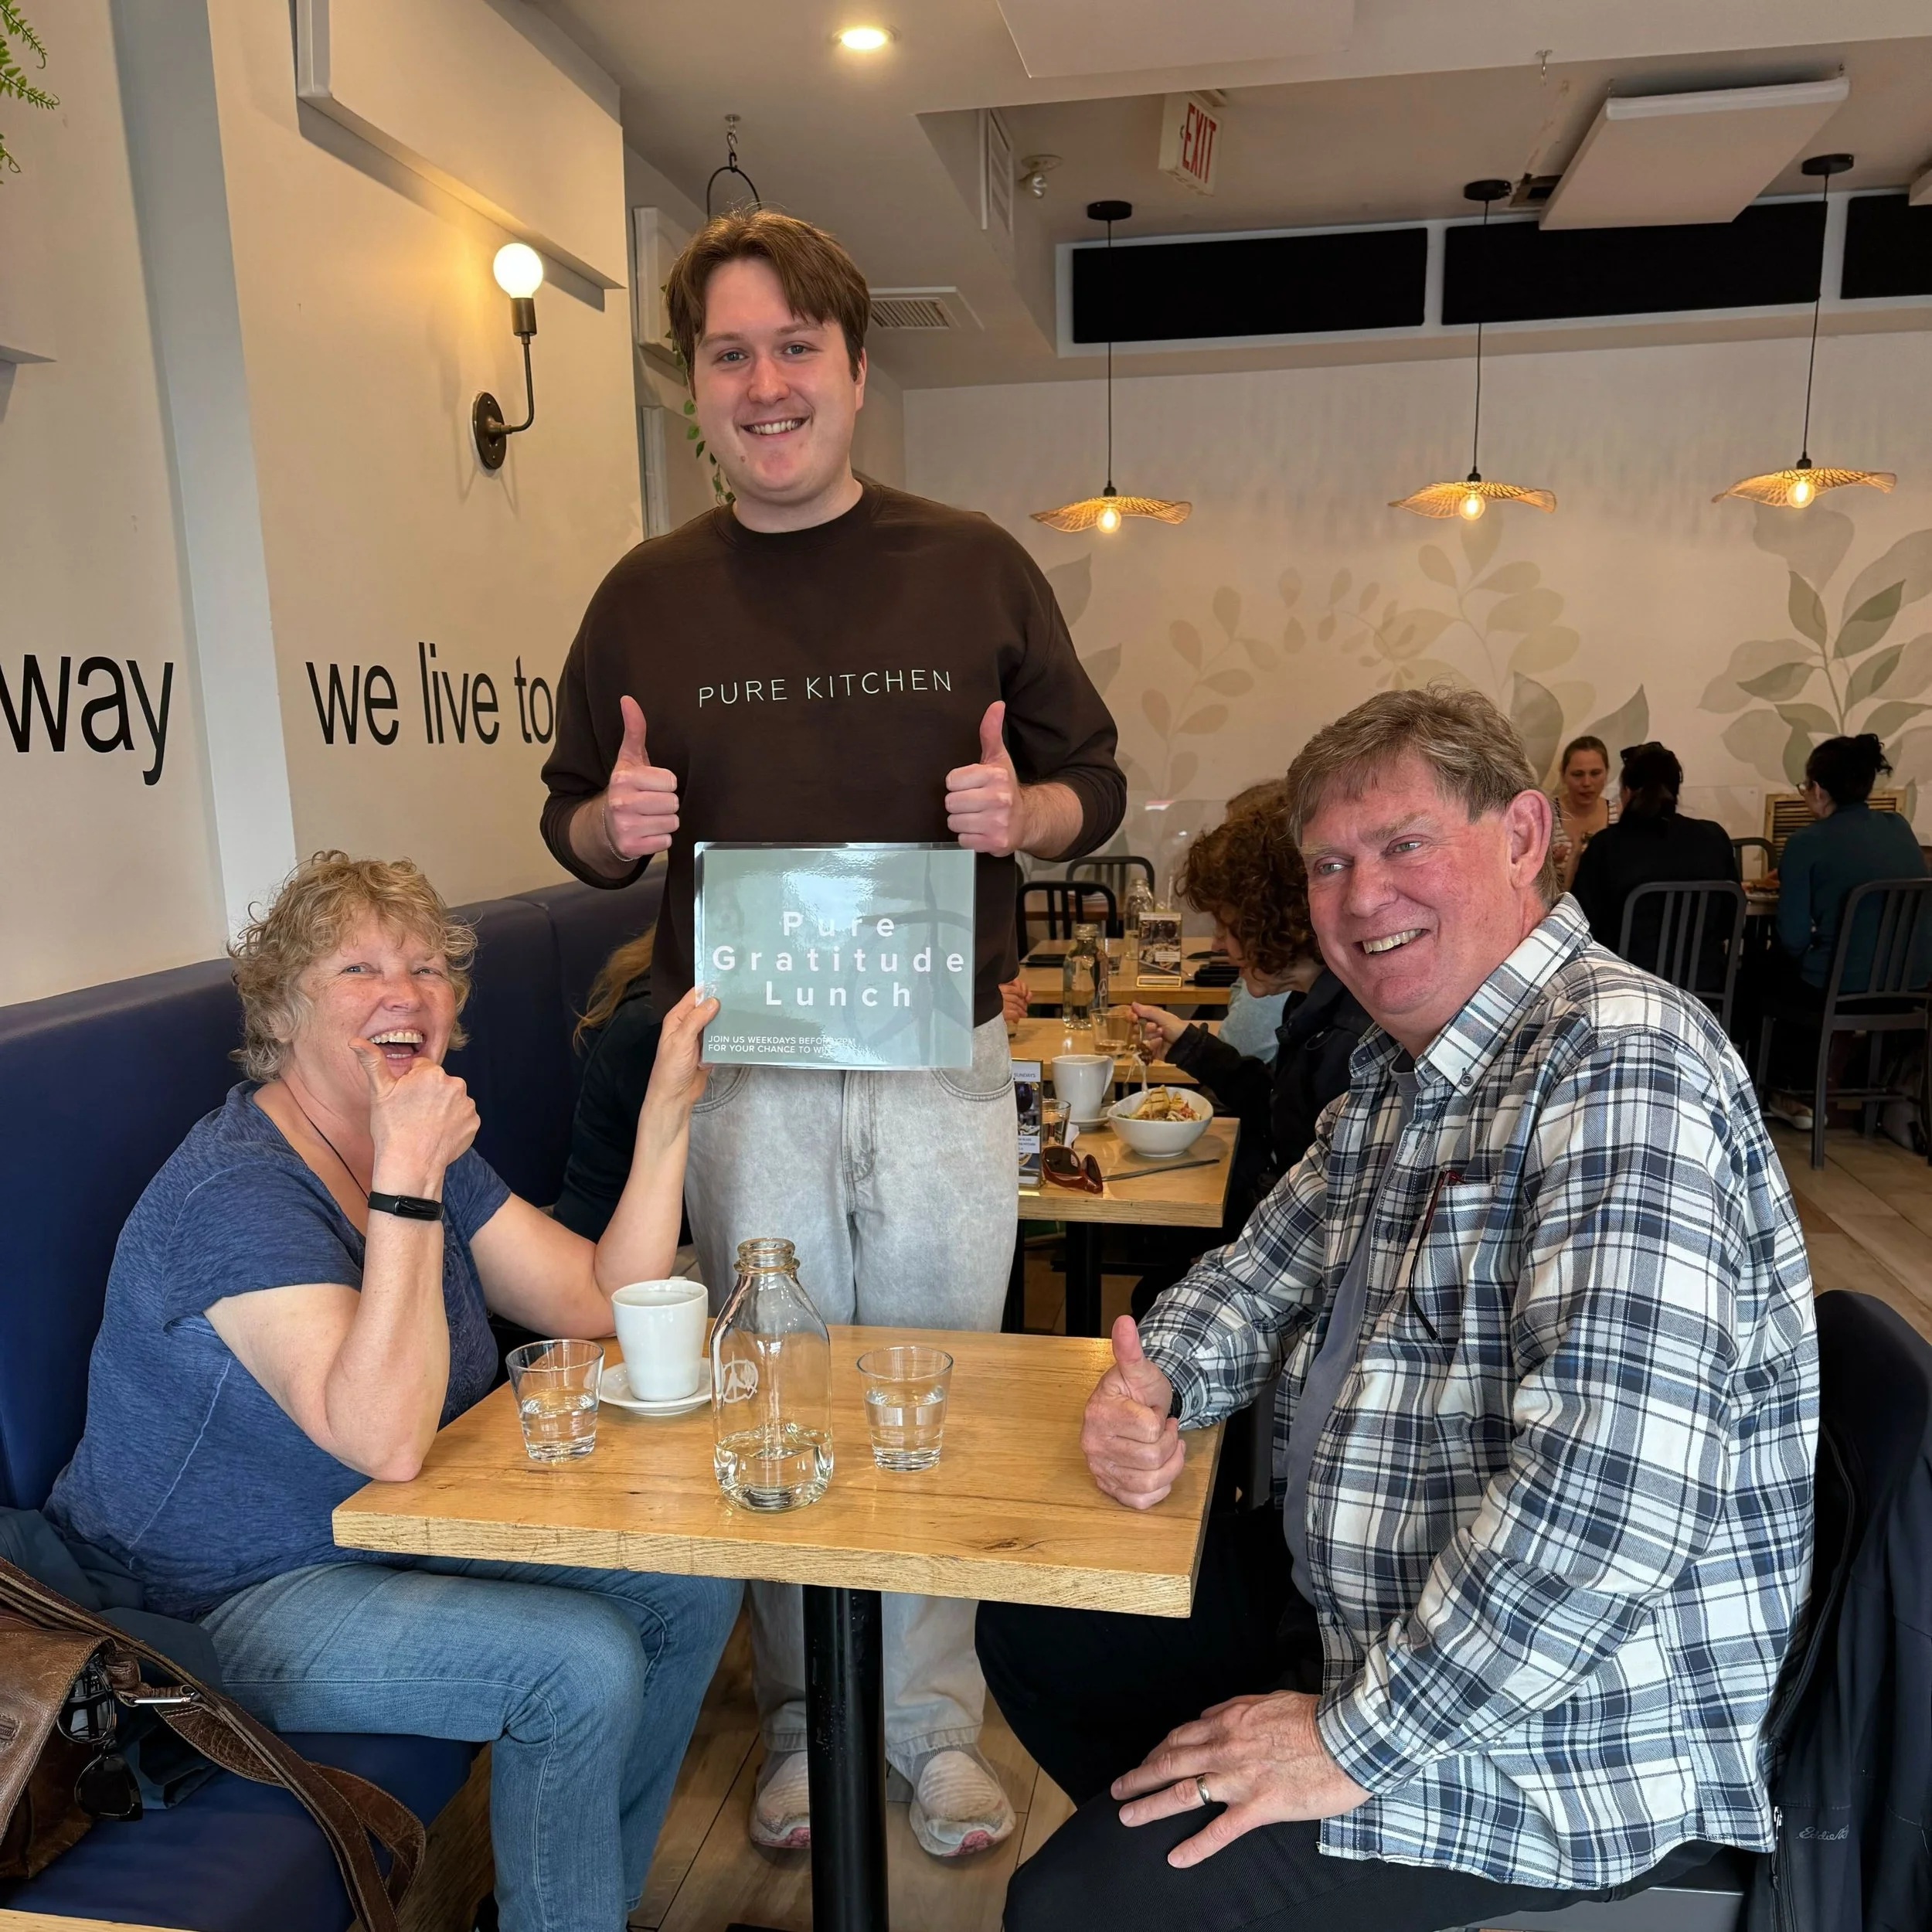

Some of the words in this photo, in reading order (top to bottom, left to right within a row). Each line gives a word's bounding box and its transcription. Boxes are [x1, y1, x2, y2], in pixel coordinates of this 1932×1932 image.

[1182, 102, 1217, 184] EXIT
[305, 662, 400, 746] we
[418, 641, 500, 744] live
[699, 679, 788, 708] PURE
[806, 669, 952, 700] KITCHEN
[0, 654, 174, 786] way
[782, 910, 896, 937] Pure
[712, 945, 965, 972] Gratitude
[765, 981, 911, 1007] Lunch
